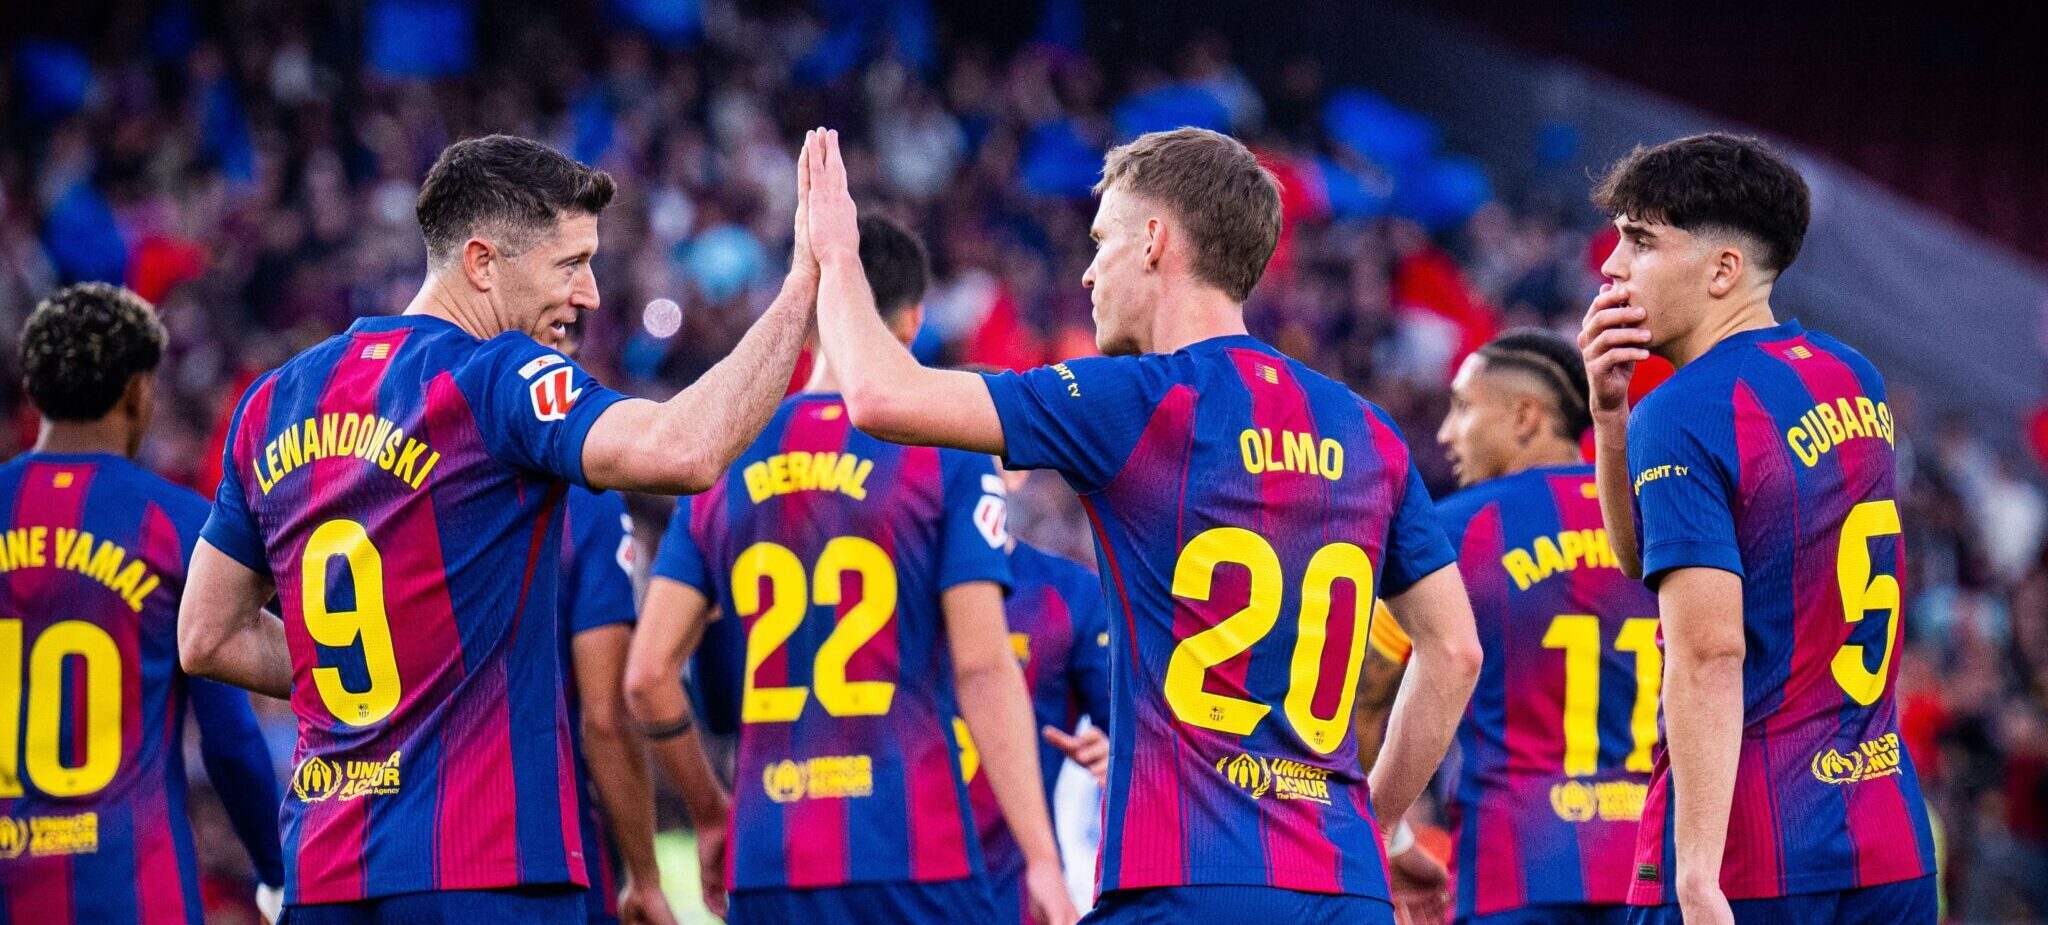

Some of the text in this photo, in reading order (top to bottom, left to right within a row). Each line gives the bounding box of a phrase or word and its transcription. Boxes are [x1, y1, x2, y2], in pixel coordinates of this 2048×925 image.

[253, 412, 441, 496] LEWANDOWSKI
[744, 451, 874, 504] BERNAL
[1240, 428, 1344, 480] OLMO
[1675, 464, 1688, 476] tv
[55, 526, 161, 613] YAMAL
[302, 519, 402, 726] 9
[731, 535, 898, 723] 22
[1831, 499, 1901, 706] 5
[1164, 527, 1373, 754] 20
[1541, 614, 1662, 778] 11
[0, 618, 123, 798] 10
[1275, 775, 1330, 799] ACNUR
